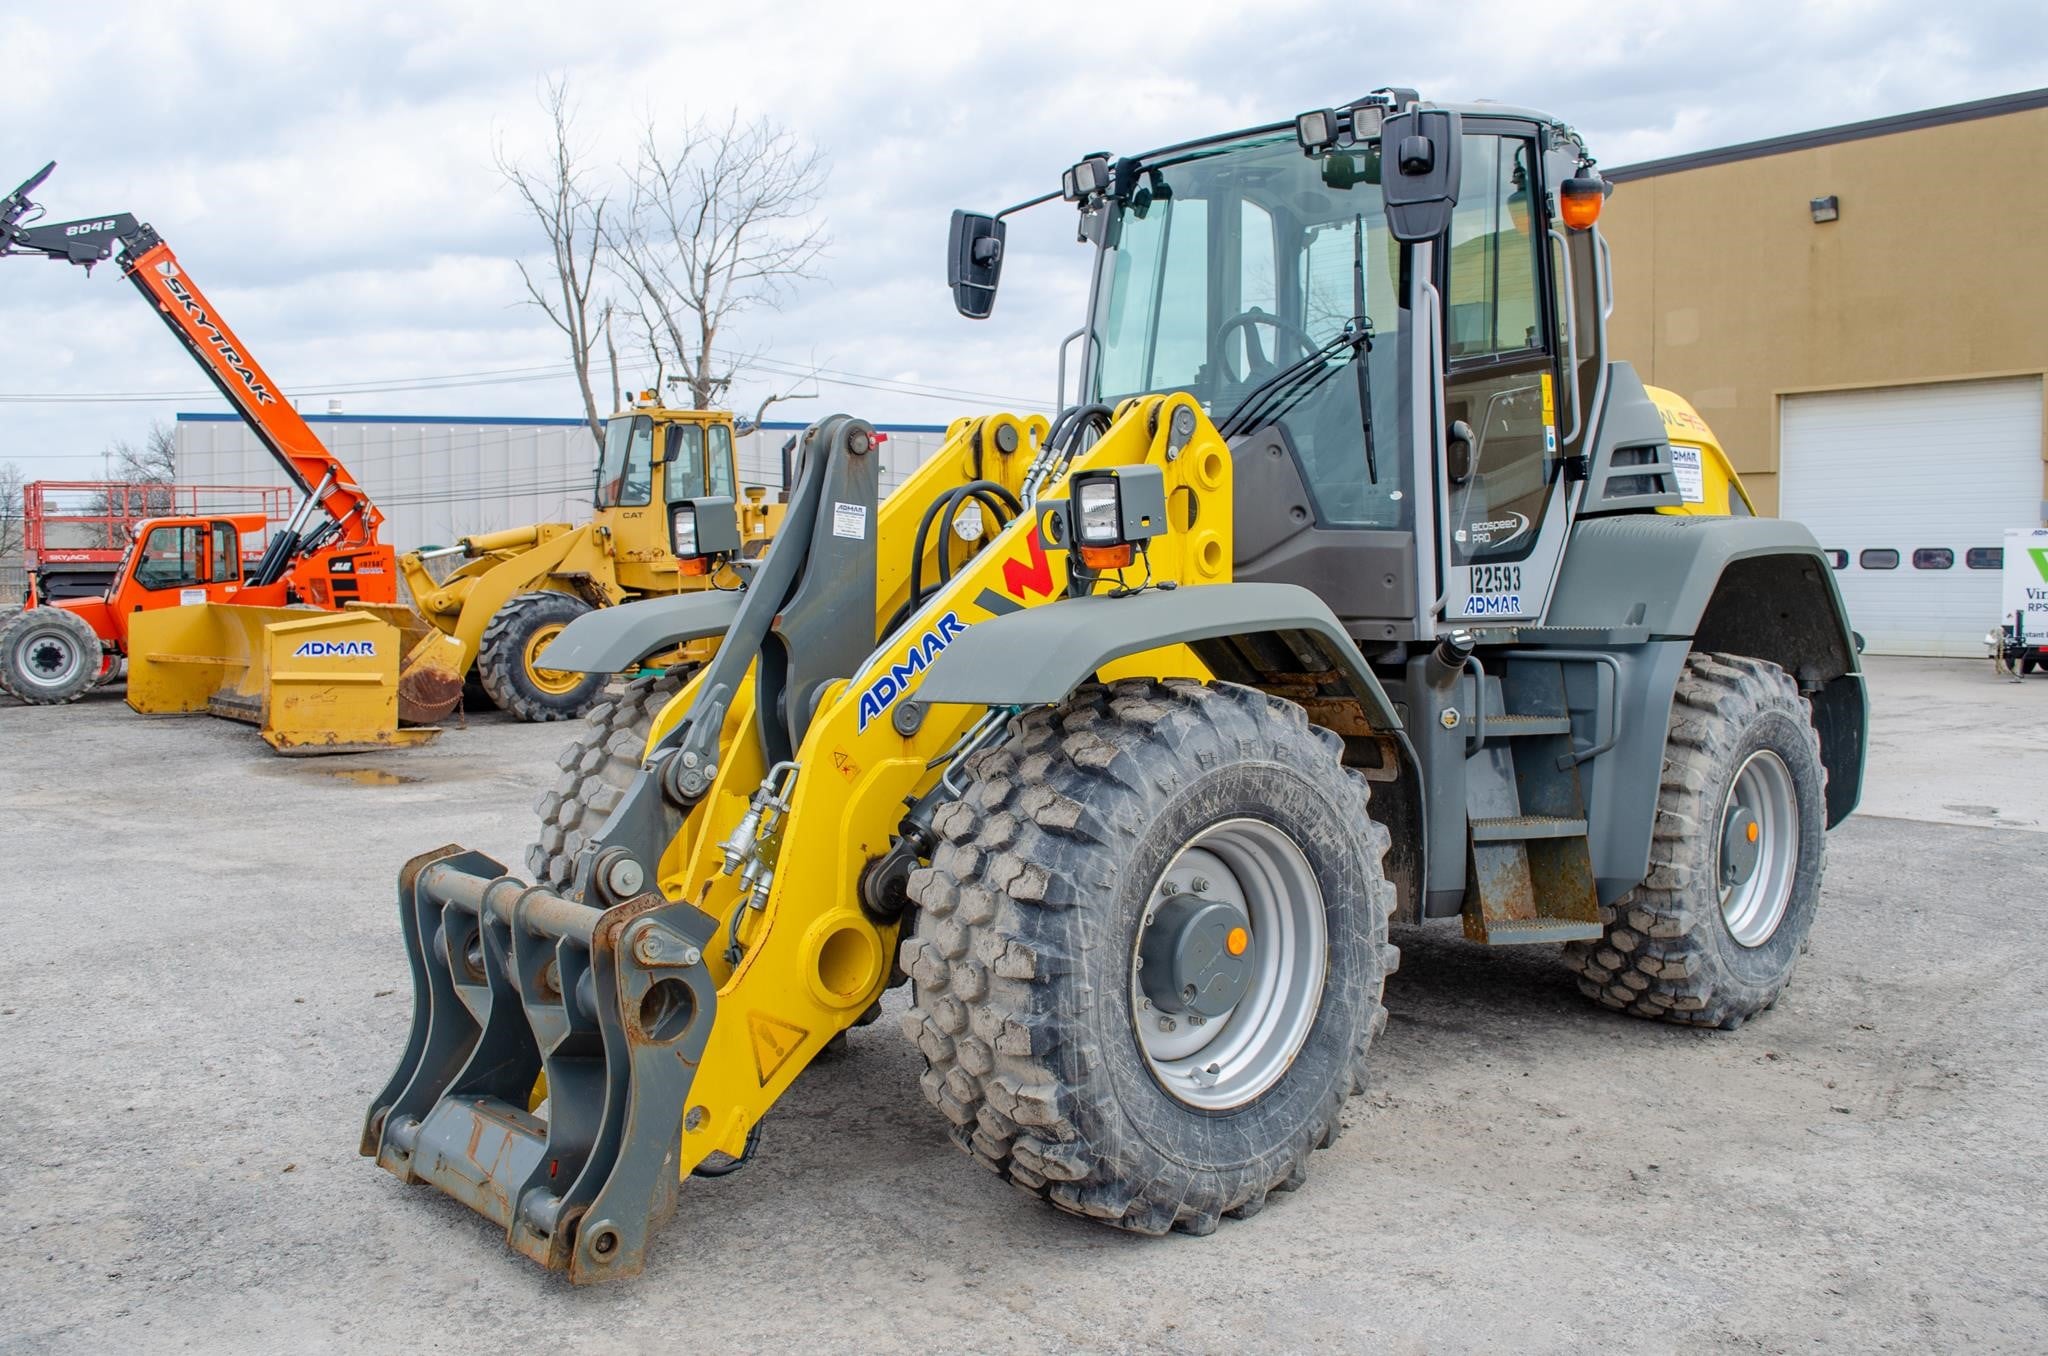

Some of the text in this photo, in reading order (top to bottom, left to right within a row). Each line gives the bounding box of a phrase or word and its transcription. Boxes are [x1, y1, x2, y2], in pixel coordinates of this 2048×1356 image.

[65, 220, 116, 236] 8042
[163, 277, 277, 406] SKYTRAK
[622, 511, 643, 519] CAT
[1471, 518, 1517, 532] ecospeed
[1472, 533, 1491, 543] PRO
[1470, 566, 1521, 594] 122593
[1463, 595, 1521, 614] ADMAR
[294, 642, 375, 656] ADMAR
[859, 612, 968, 733] ADMAR
